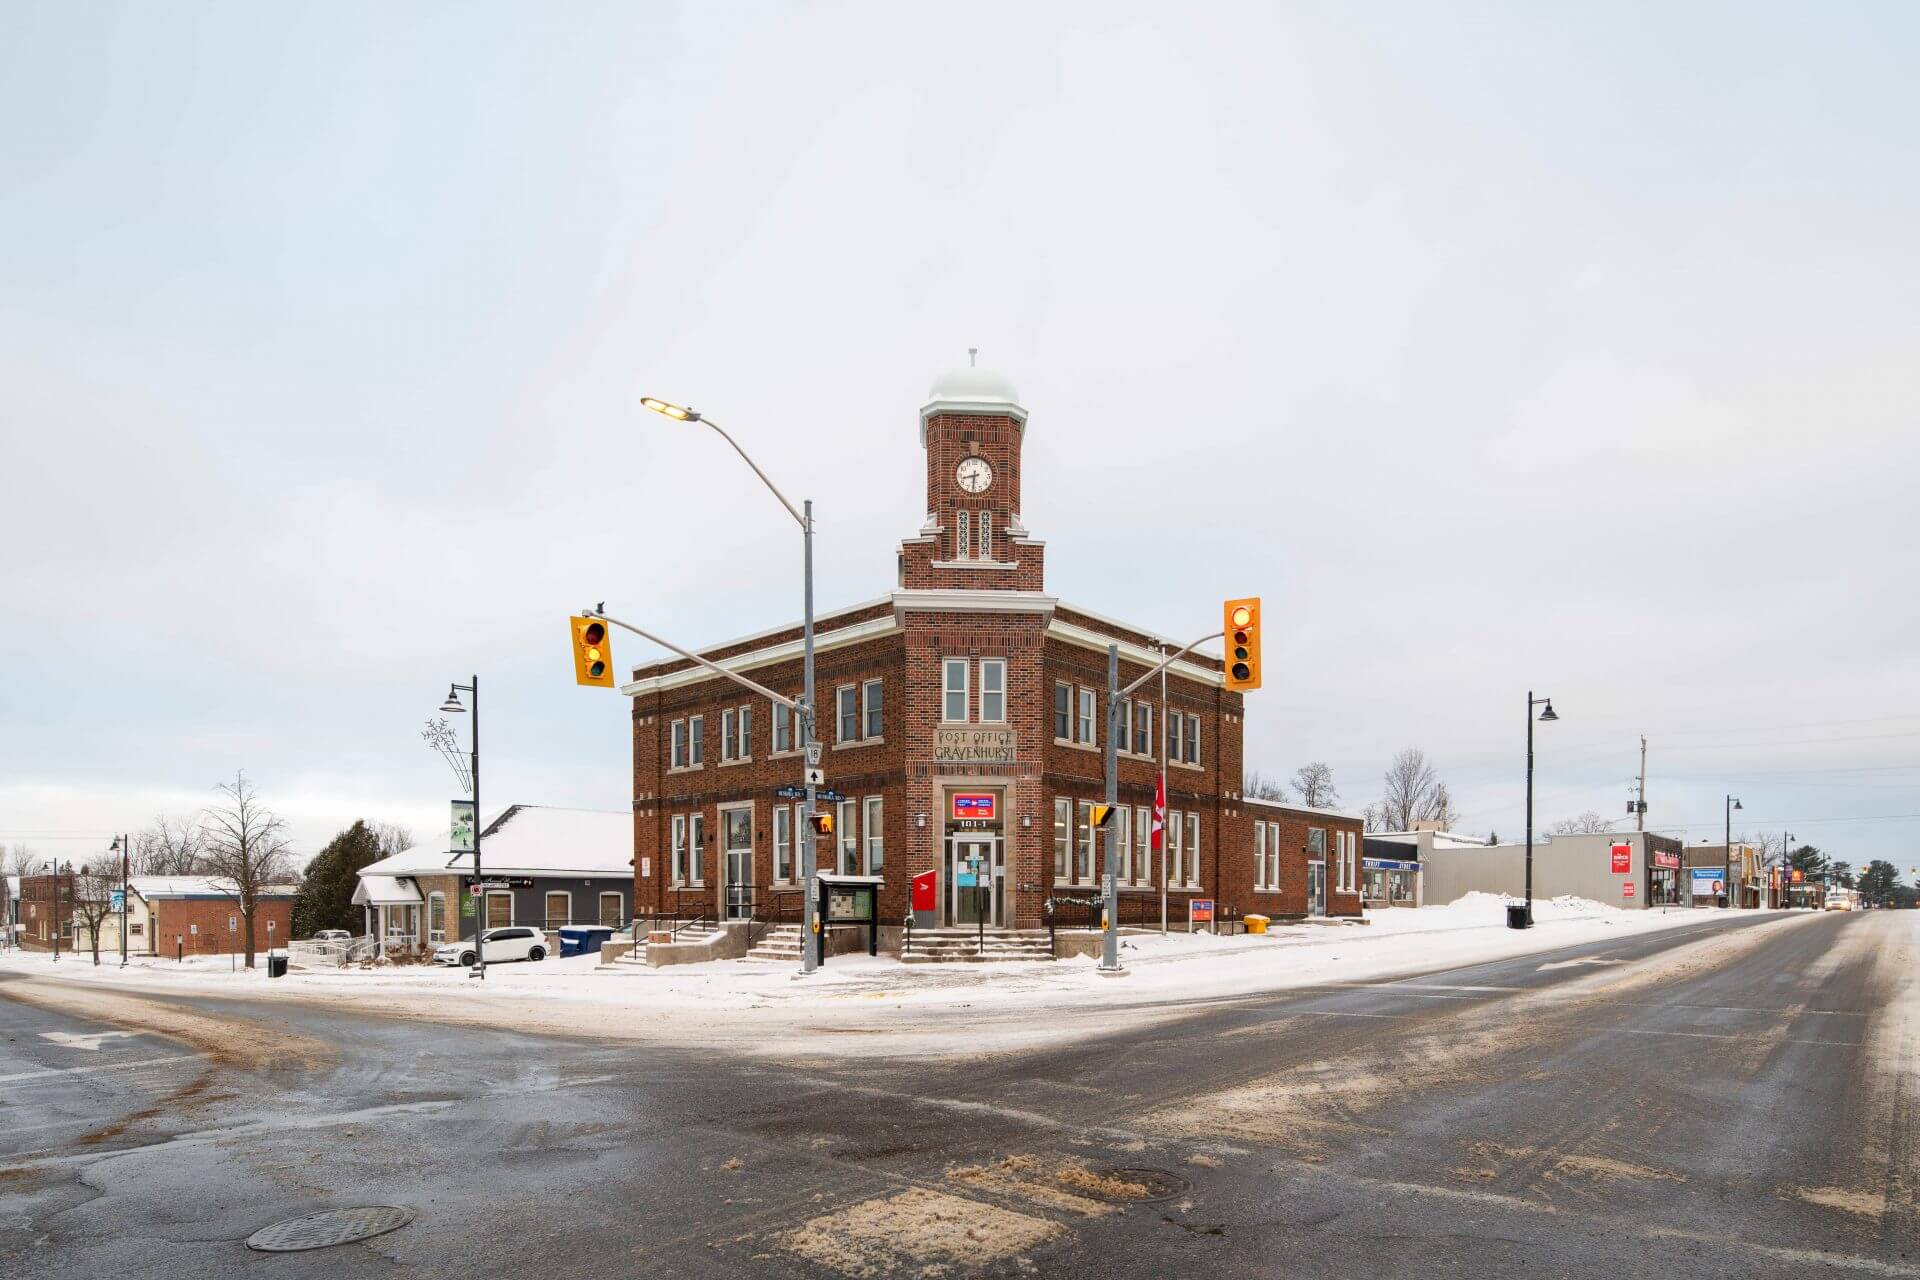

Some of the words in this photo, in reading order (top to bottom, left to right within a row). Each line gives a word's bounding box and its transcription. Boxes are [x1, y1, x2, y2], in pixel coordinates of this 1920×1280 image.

[939, 732, 967, 742] POST
[973, 732, 1011, 742] OFFICE
[935, 746, 1015, 759] GRAVENHURST
[961, 820, 986, 828] 101-1
[1365, 860, 1380, 868] THRIFT
